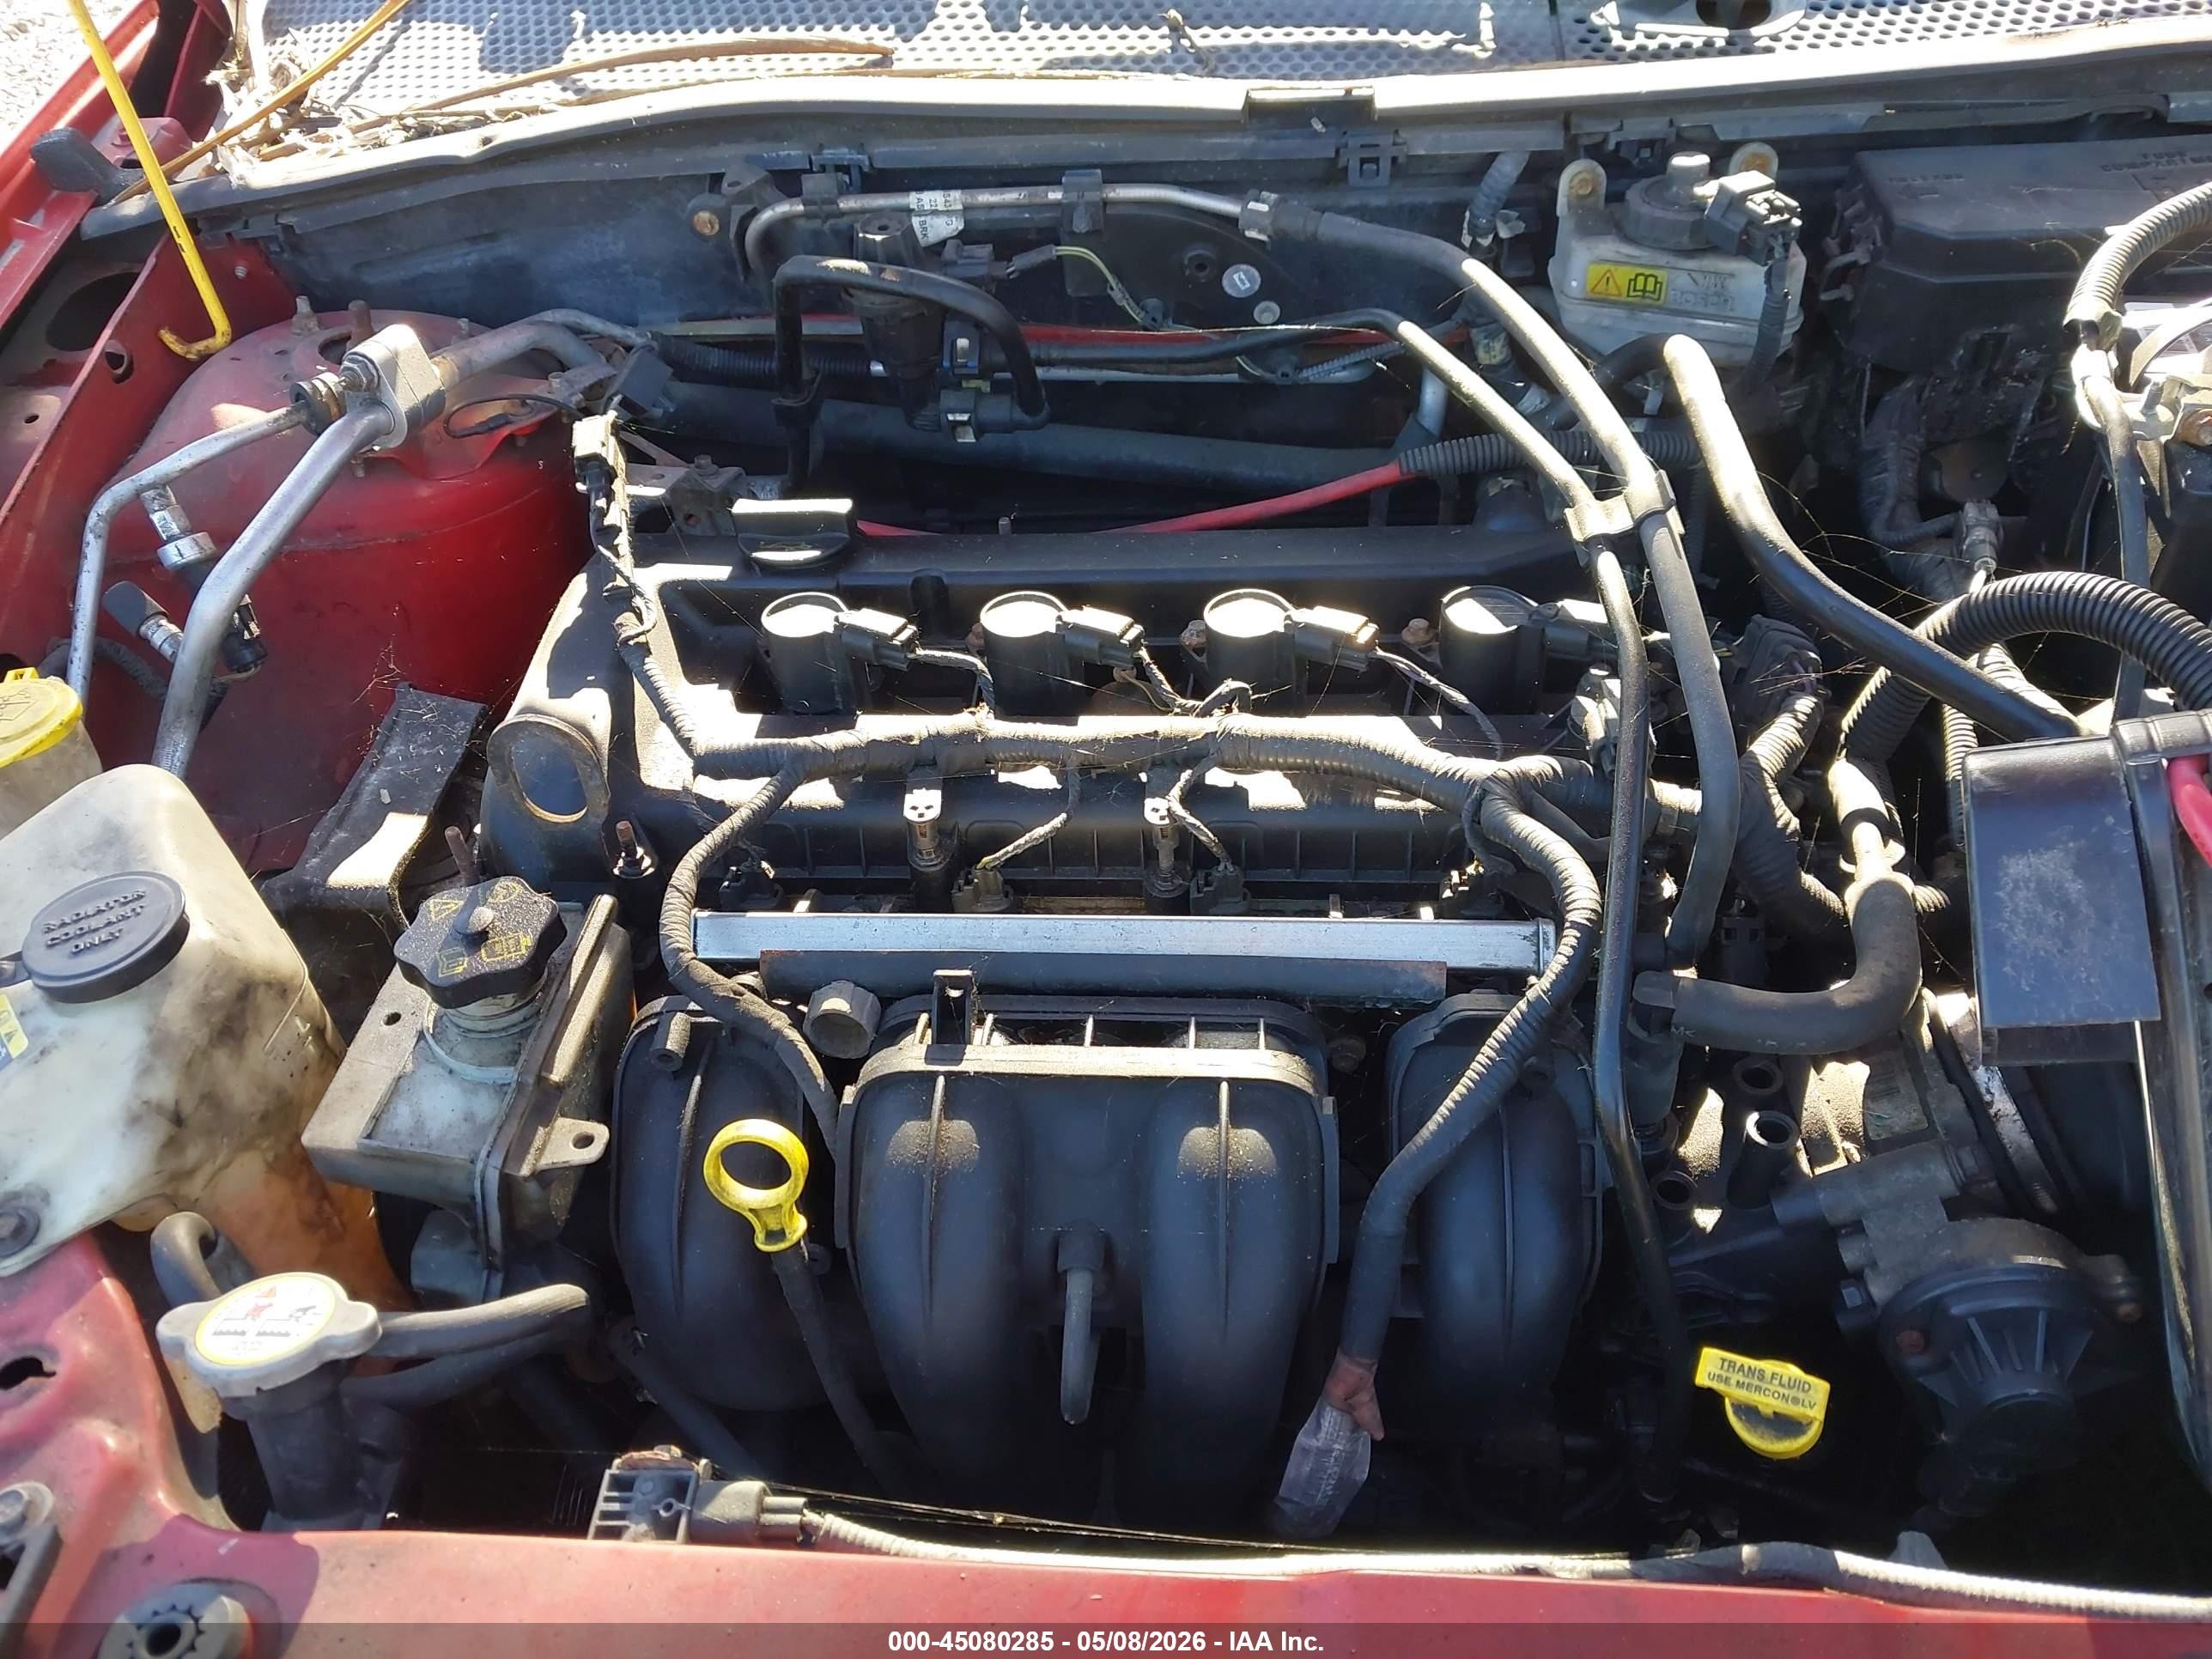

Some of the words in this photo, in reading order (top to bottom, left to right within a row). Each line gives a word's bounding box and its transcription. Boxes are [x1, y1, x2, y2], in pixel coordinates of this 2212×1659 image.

[919, 219, 929, 240] BRK
[42, 888, 147, 934] RADIATOR
[46, 903, 145, 948] COOLANT
[70, 927, 124, 955] ONLY
[1707, 1370, 1732, 1386] USE
[1719, 1357, 1766, 1382] TRANS
[1770, 1371, 1812, 1395] FLUID
